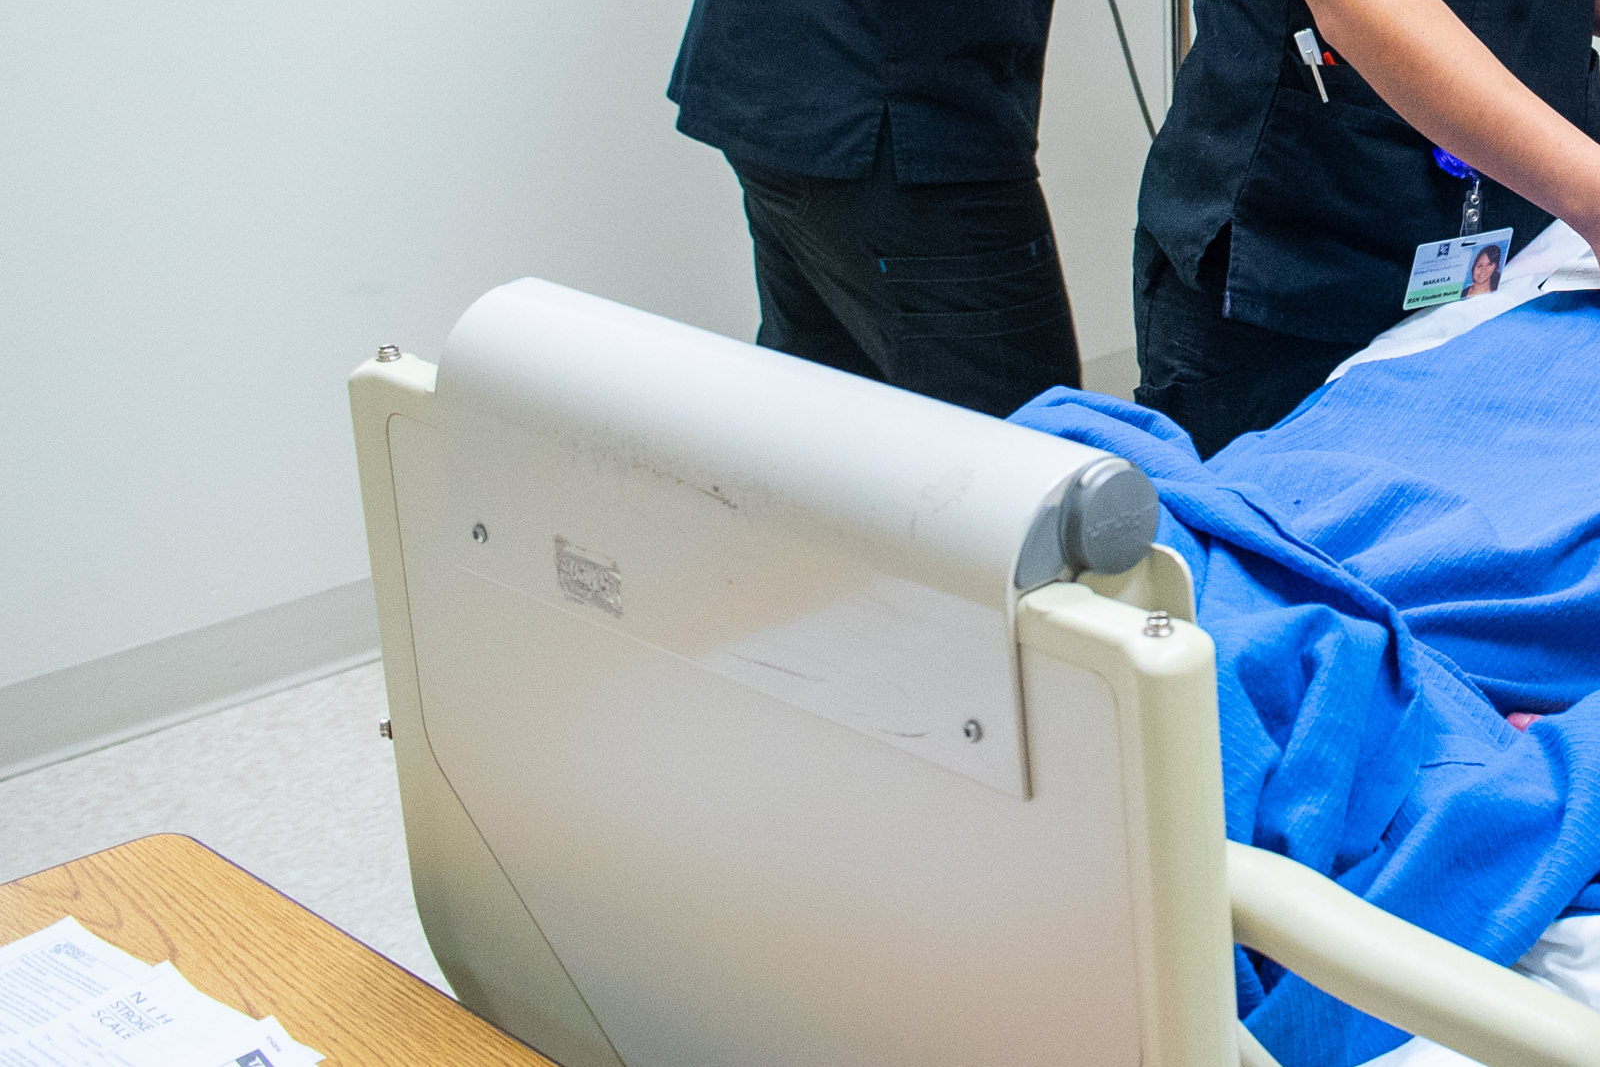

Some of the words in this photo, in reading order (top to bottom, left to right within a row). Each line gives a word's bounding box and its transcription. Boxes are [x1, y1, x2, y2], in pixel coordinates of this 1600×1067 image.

[1423, 276, 1450, 286] MAKAYLA
[1421, 293, 1442, 302] Student
[91, 1009, 137, 1040] SCALE
[110, 1000, 155, 1032] STROKE
